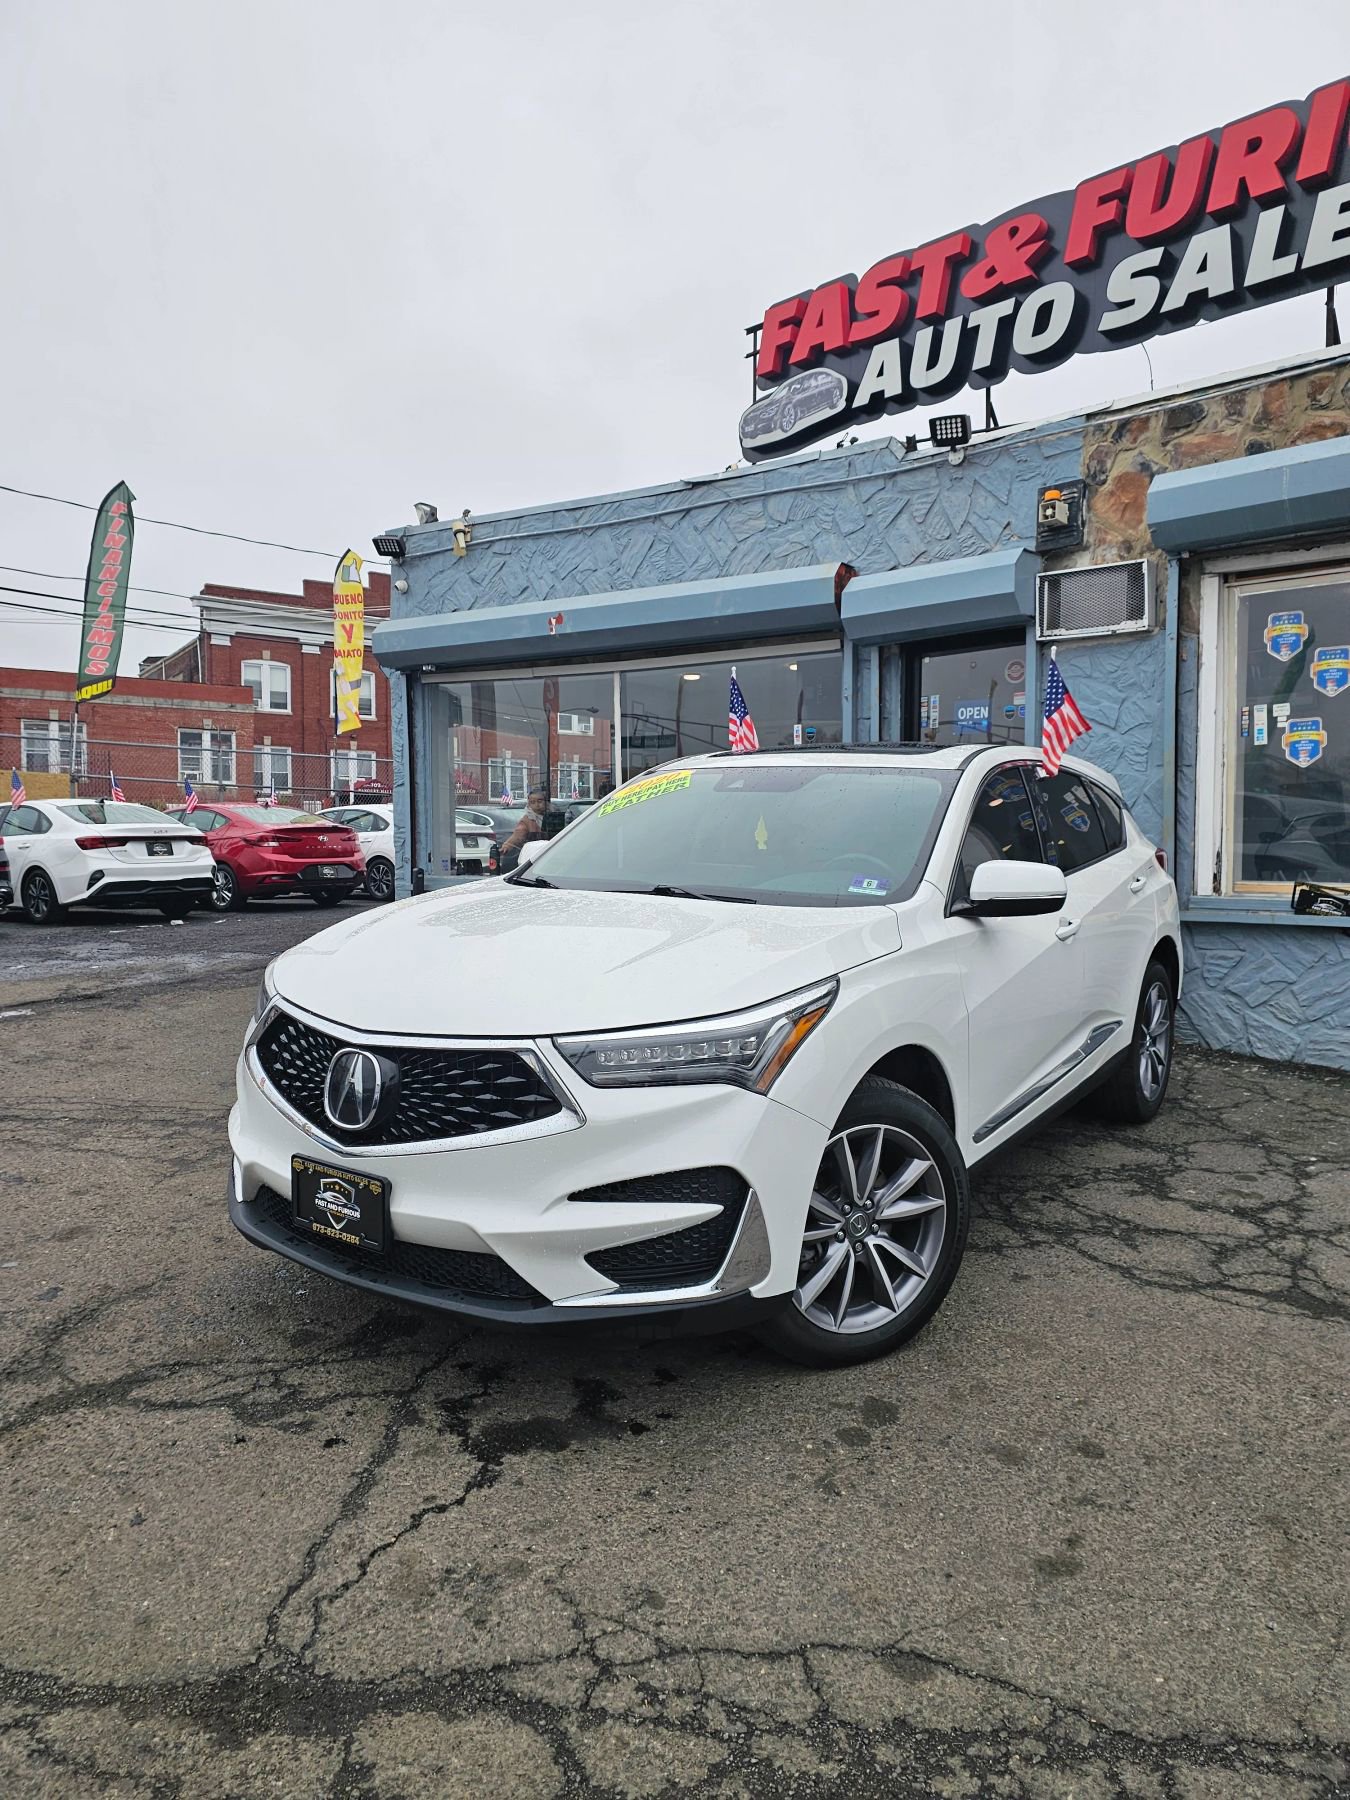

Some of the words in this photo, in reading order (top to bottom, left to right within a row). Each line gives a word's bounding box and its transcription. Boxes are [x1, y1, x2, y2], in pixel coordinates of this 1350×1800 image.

[756, 232, 971, 377] FAST
[959, 213, 1051, 301] &
[1064, 79, 1350, 267] FURI
[851, 280, 1075, 409] AUTO
[84, 501, 128, 676] FINANCIAMOS
[334, 592, 363, 605] BUENO
[341, 623, 354, 643] Y
[958, 706, 989, 720] OPEN
[600, 781, 688, 816] LEATHER
[315, 1198, 328, 1208] FAST
[327, 1202, 338, 1212] AND
[338, 1204, 360, 1219] FURIOUS
